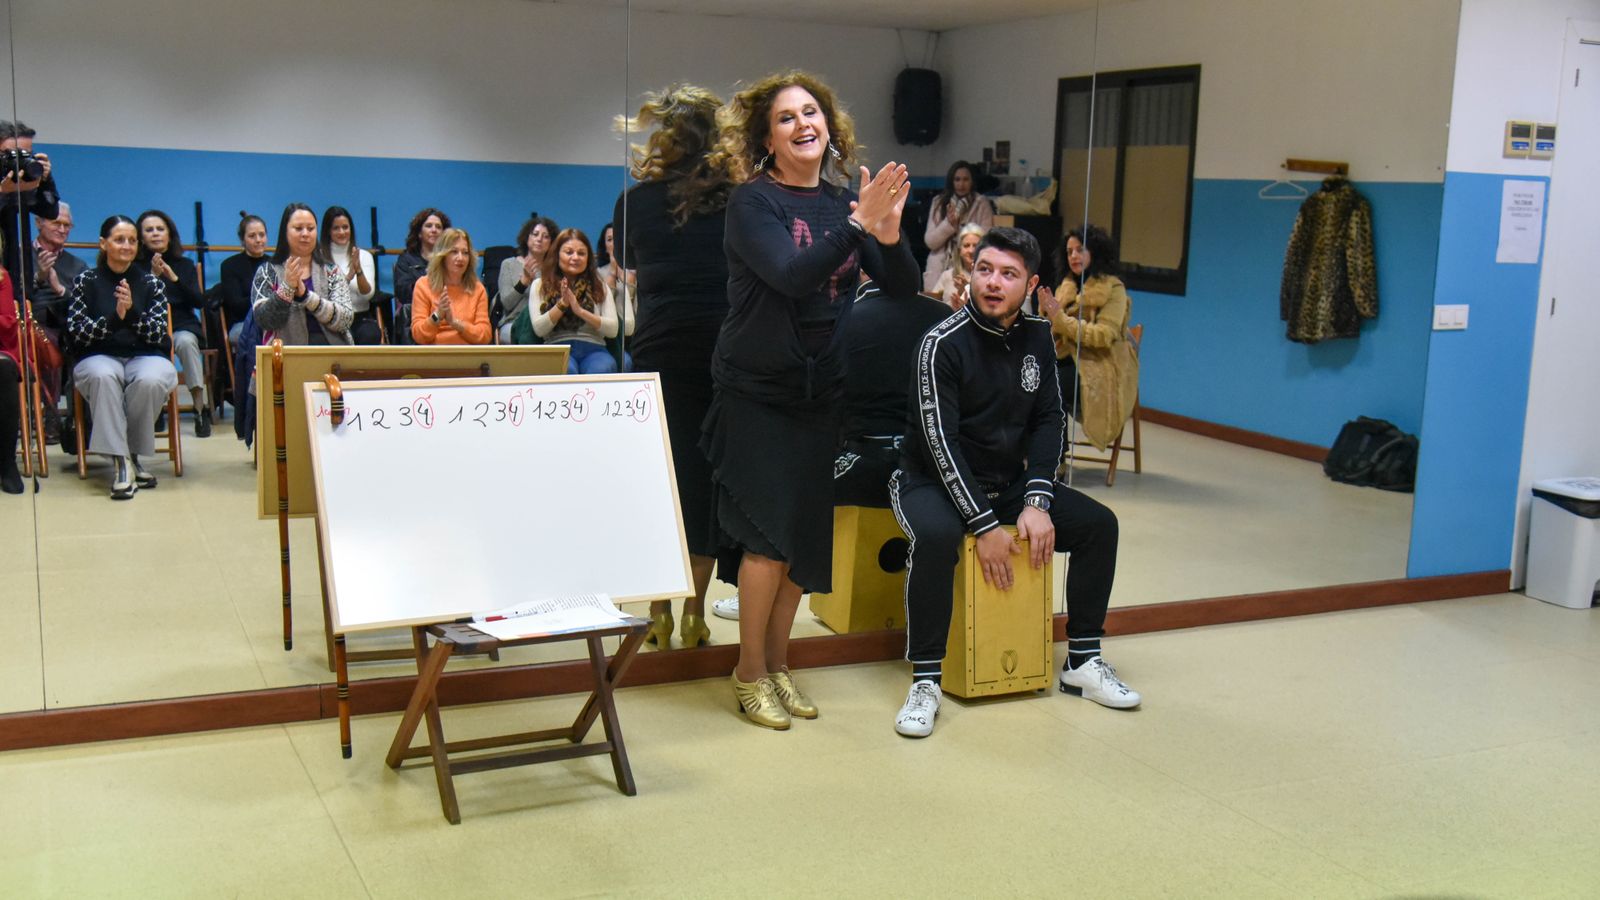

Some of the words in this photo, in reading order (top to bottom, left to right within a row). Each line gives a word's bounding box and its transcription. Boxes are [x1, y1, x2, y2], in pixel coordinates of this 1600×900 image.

[921, 338, 933, 371] GABBANA
[920, 375, 930, 396] DOLCE
[926, 412, 939, 445] GABBANA
[934, 448, 948, 469] DOLCE
[950, 482, 972, 516] GABBANA
